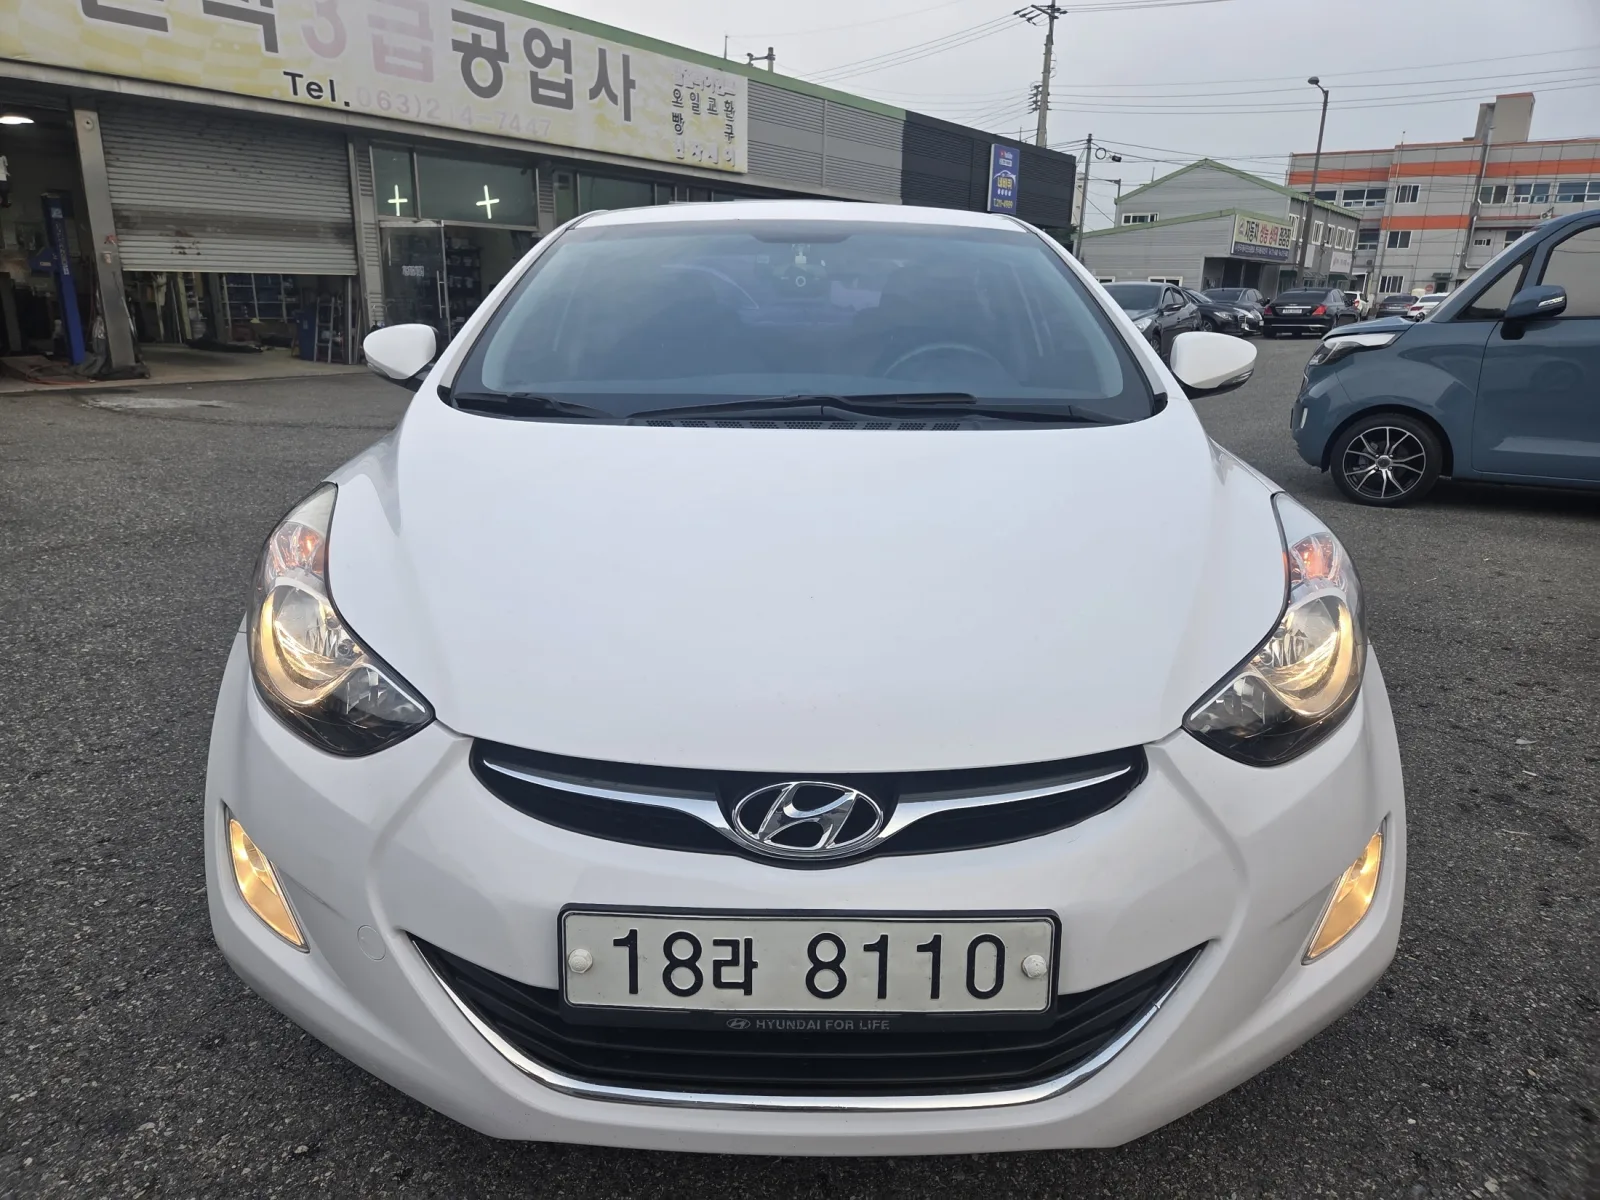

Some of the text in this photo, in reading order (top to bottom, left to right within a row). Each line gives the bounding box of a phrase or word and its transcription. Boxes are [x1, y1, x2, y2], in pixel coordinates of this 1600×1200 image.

[283, 70, 350, 107] Tel.
[1245, 220, 1260, 243] 자동차
[612, 927, 1007, 1000] 18라 8110
[755, 1018, 890, 1031] HYUNDAI FOR LIFE
